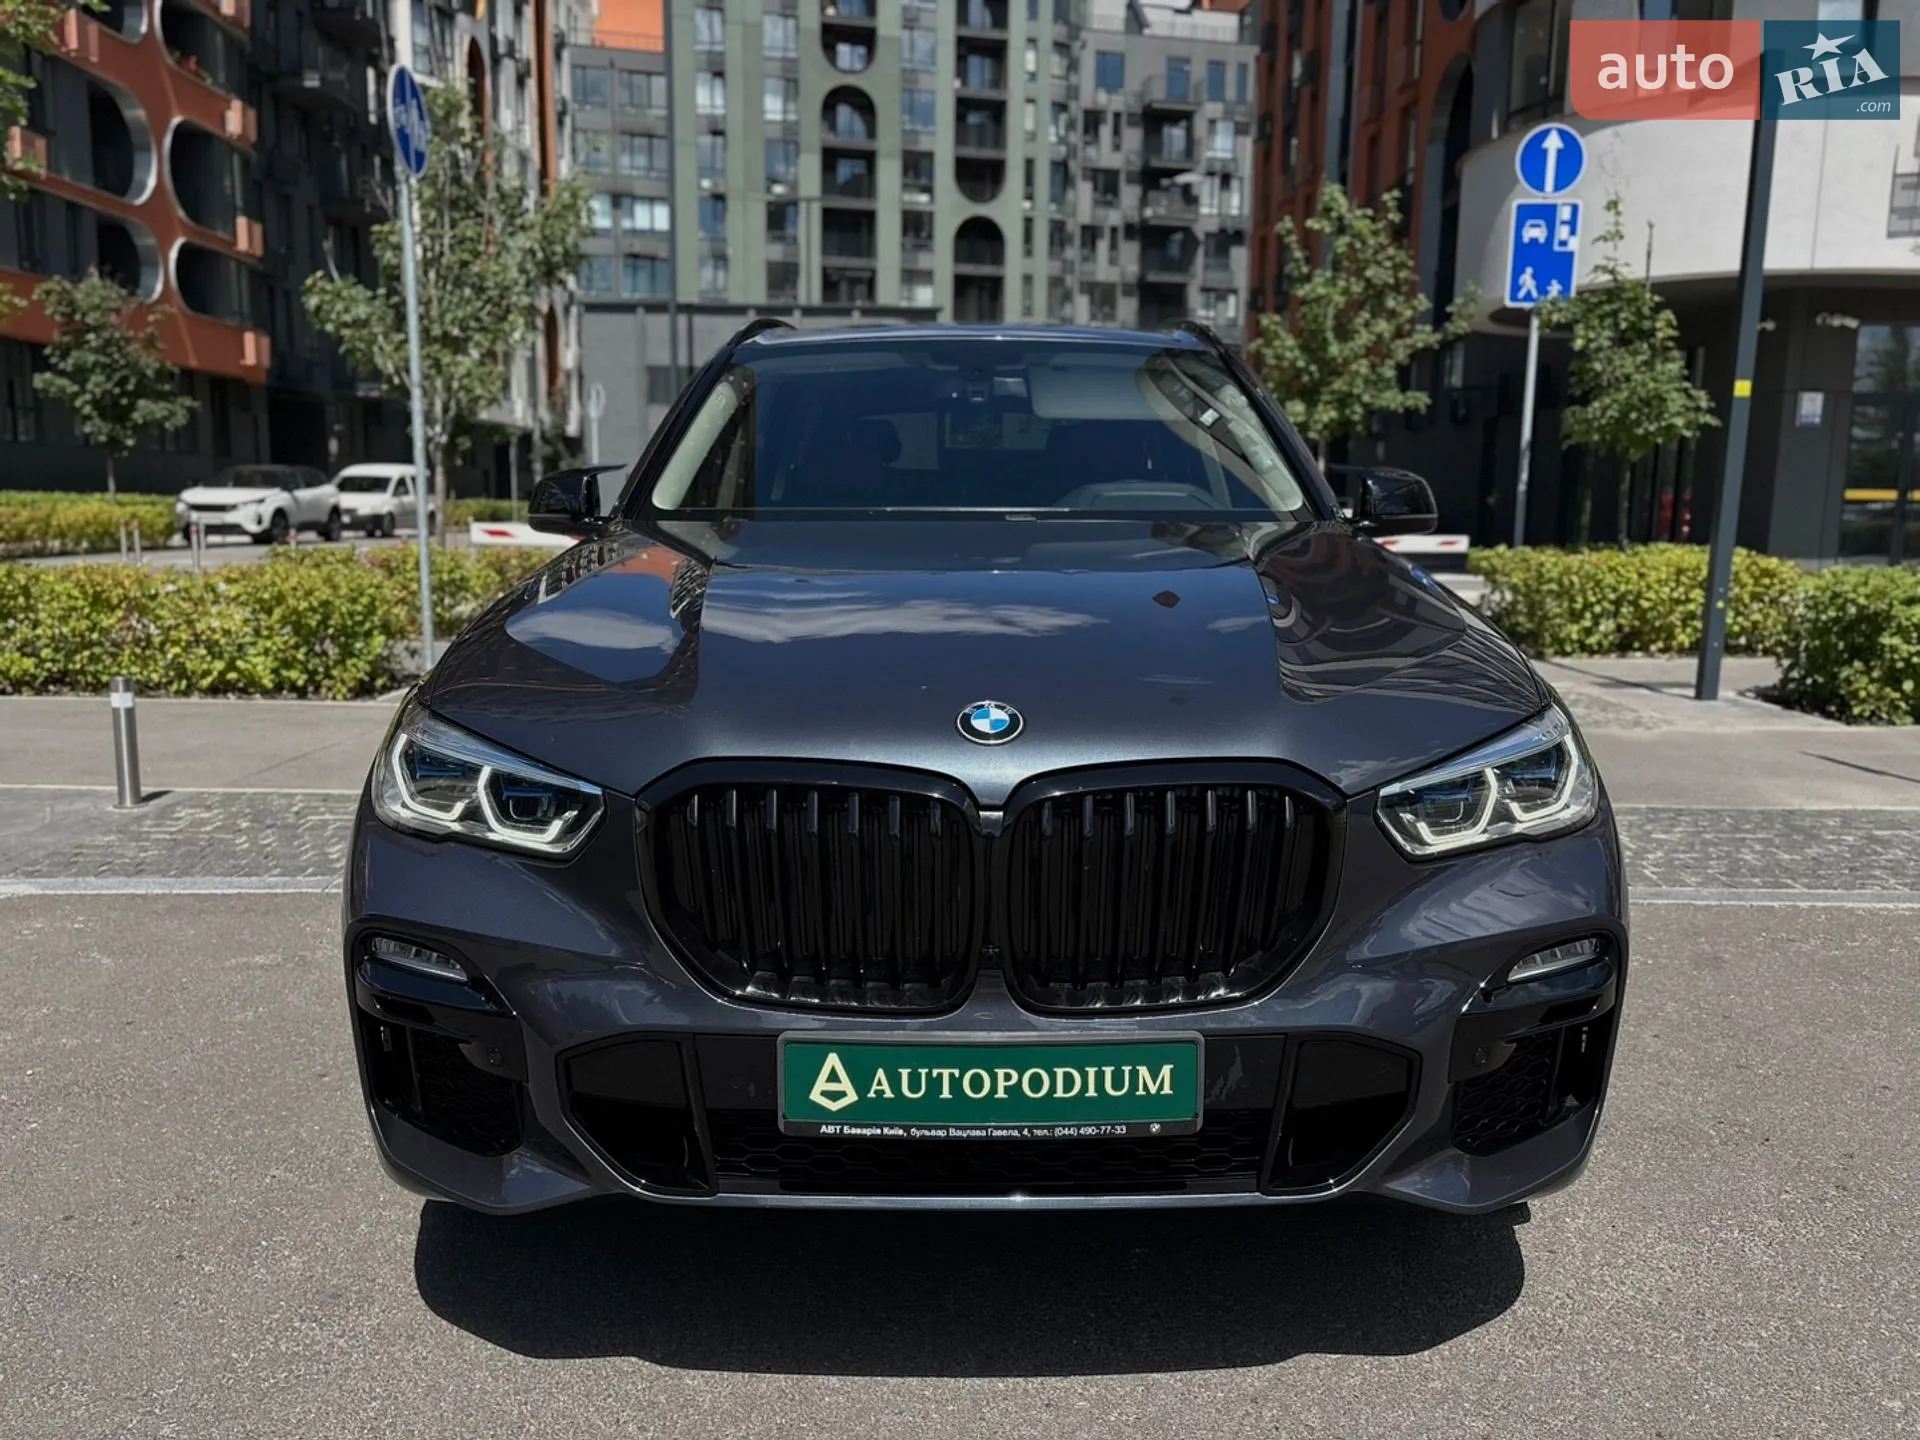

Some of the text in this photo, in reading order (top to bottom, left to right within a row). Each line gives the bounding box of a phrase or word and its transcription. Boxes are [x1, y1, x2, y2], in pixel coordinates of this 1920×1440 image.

[866, 1064, 1175, 1099] AUTOPODIUM
[1054, 1126, 1078, 1137] (044)
[1079, 1125, 1127, 1135] 490-77-33
